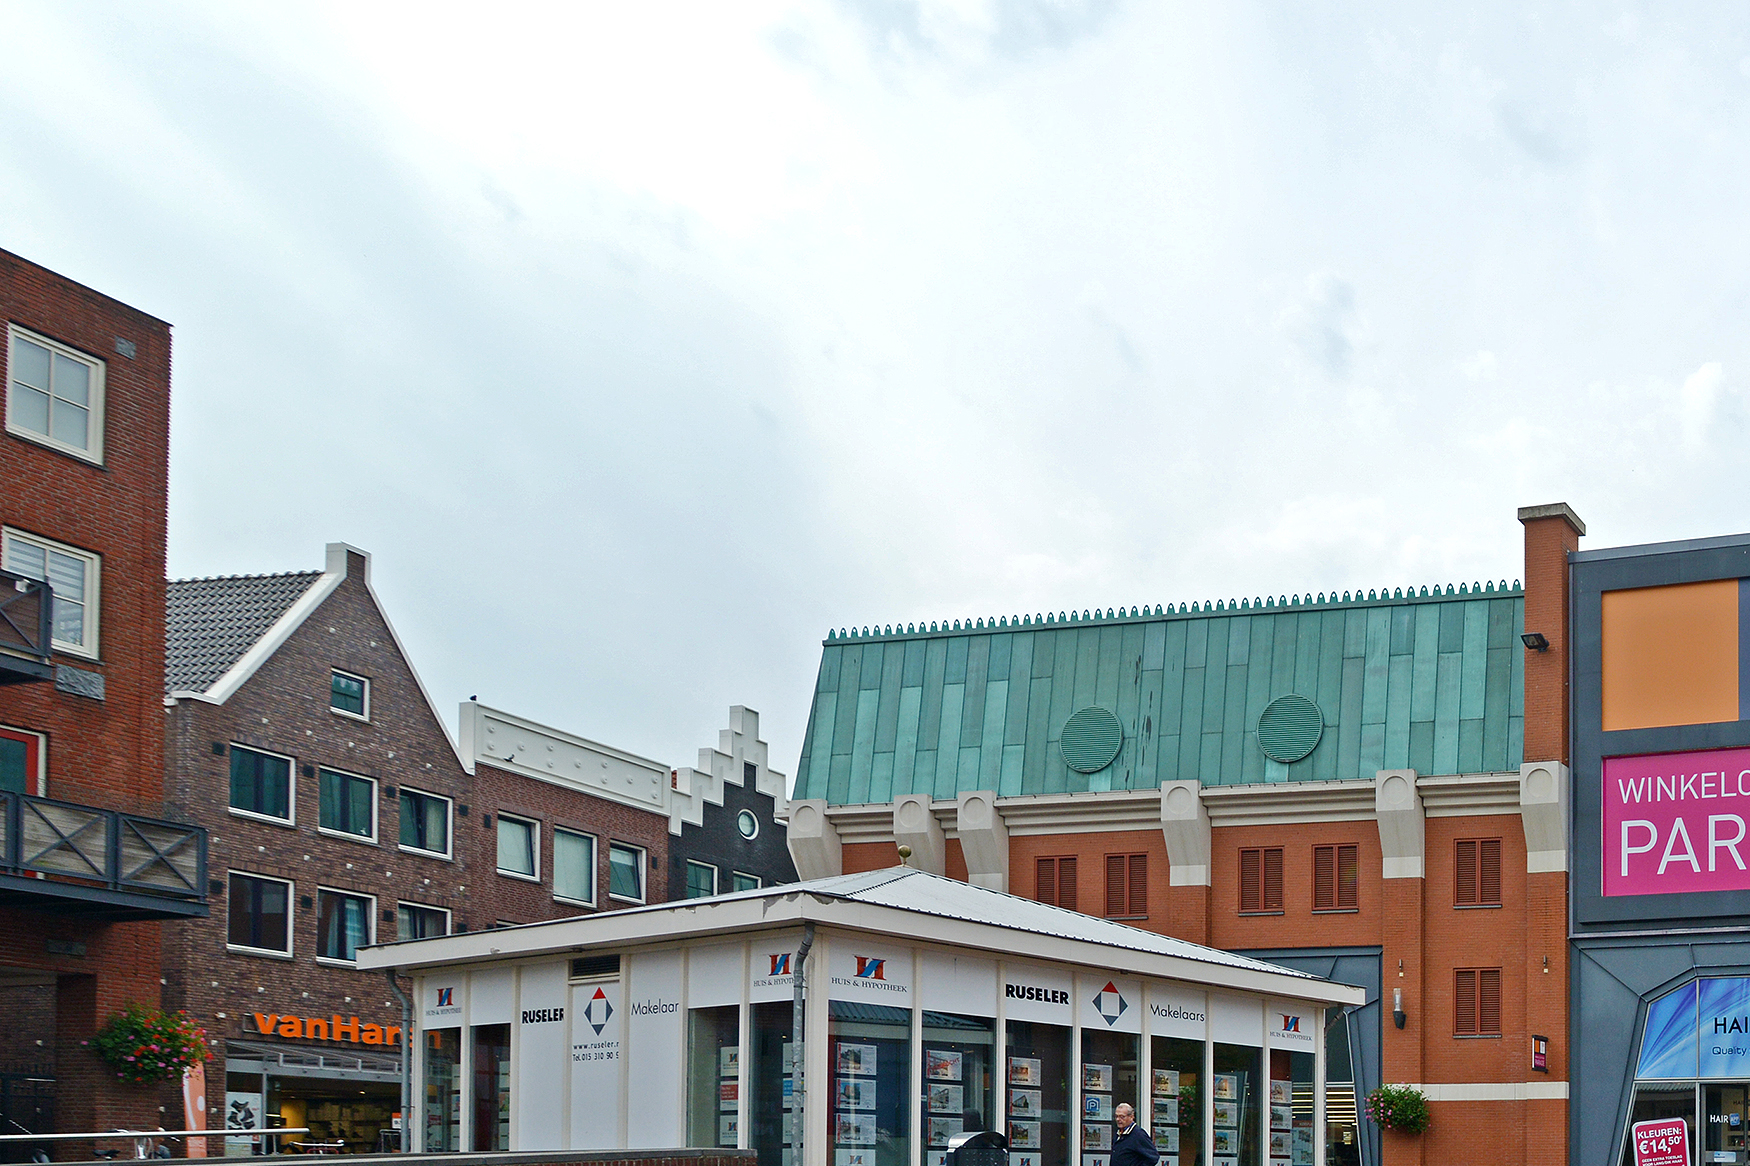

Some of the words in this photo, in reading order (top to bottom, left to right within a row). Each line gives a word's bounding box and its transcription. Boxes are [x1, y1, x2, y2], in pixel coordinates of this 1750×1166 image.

[831, 976, 851, 986] HUIS
[861, 981, 907, 993] HYPOTHEEK
[1005, 983, 1060, 1005] RUSELER
[631, 998, 679, 1016] Makelaar
[1150, 1003, 1205, 1022] Makelaars
[254, 1011, 442, 1050] vanHarn
[1709, 1114, 1729, 1124] HAIR
[1637, 1127, 1682, 1139] KLEUREN:
